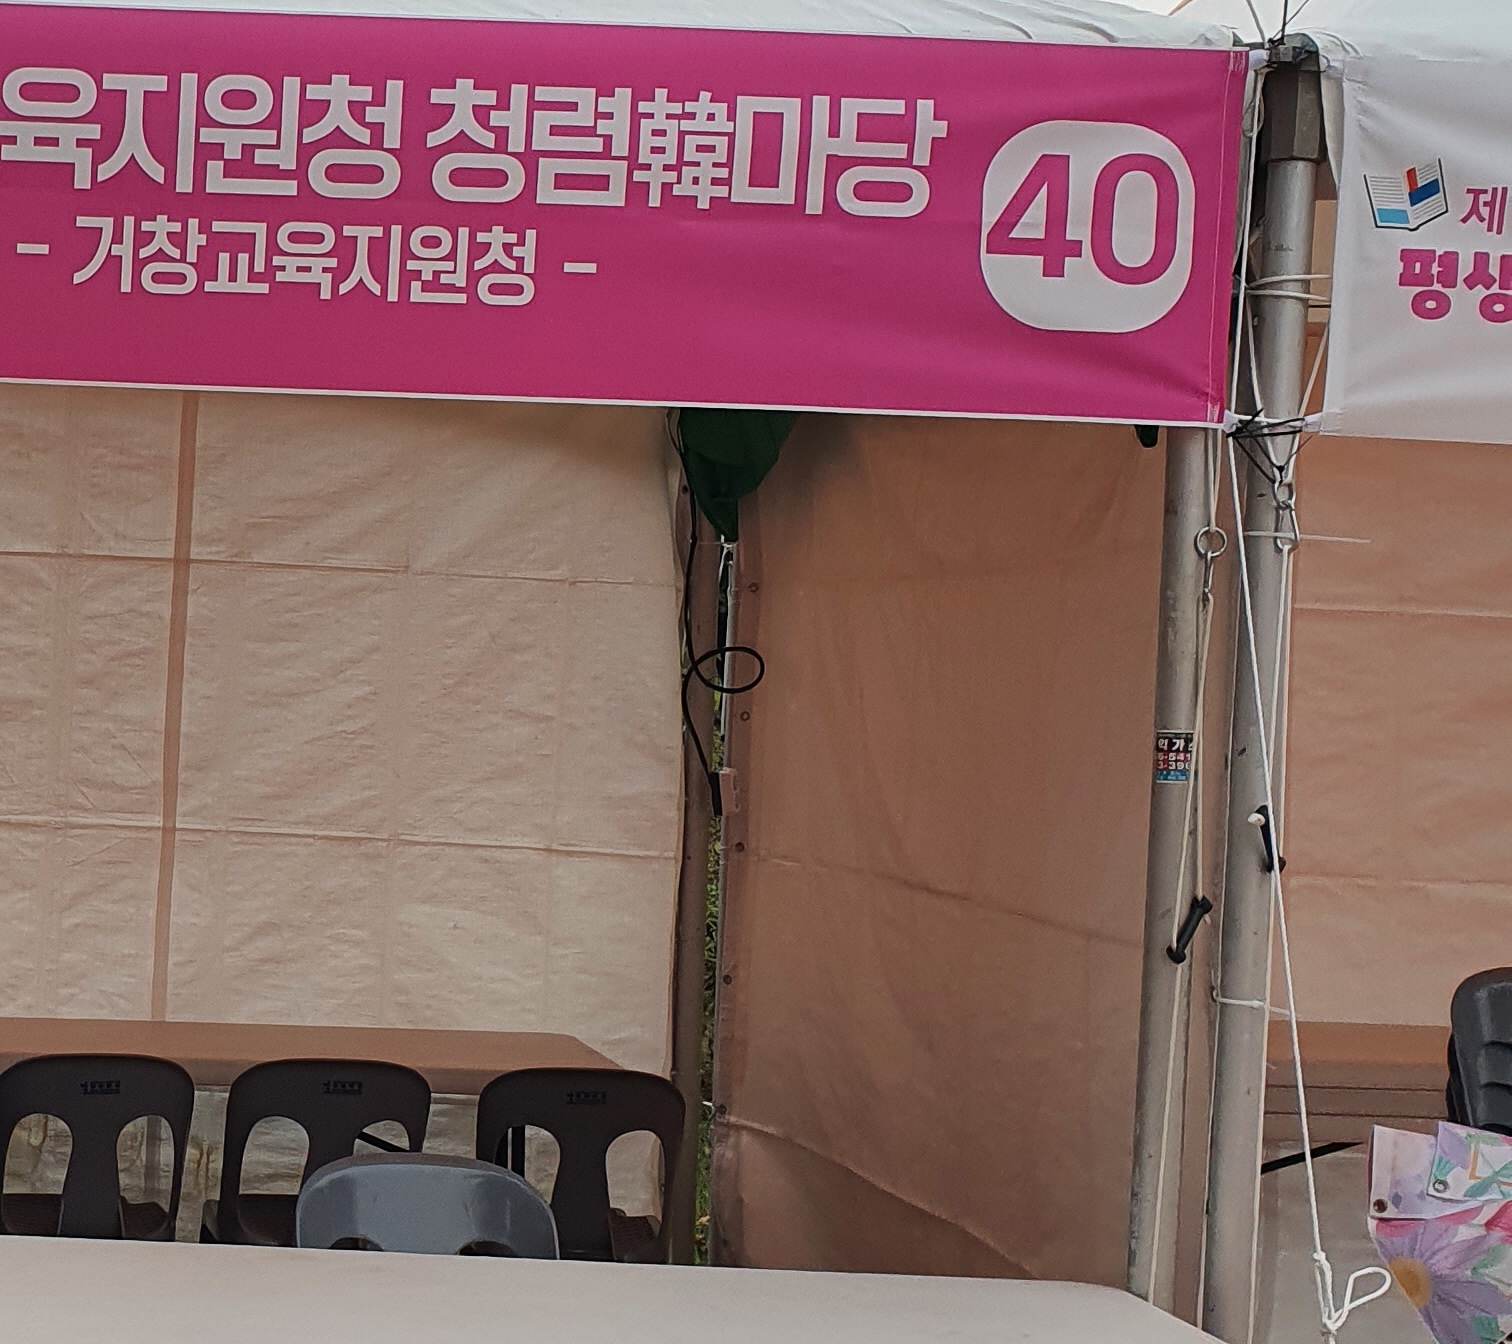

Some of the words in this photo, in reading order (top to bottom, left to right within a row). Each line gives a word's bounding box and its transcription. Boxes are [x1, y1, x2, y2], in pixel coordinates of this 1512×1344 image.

[426, 78, 949, 218] 청렴韓마당
[72, 214, 537, 306] 거창교육지원청
[984, 152, 1179, 286] 40
